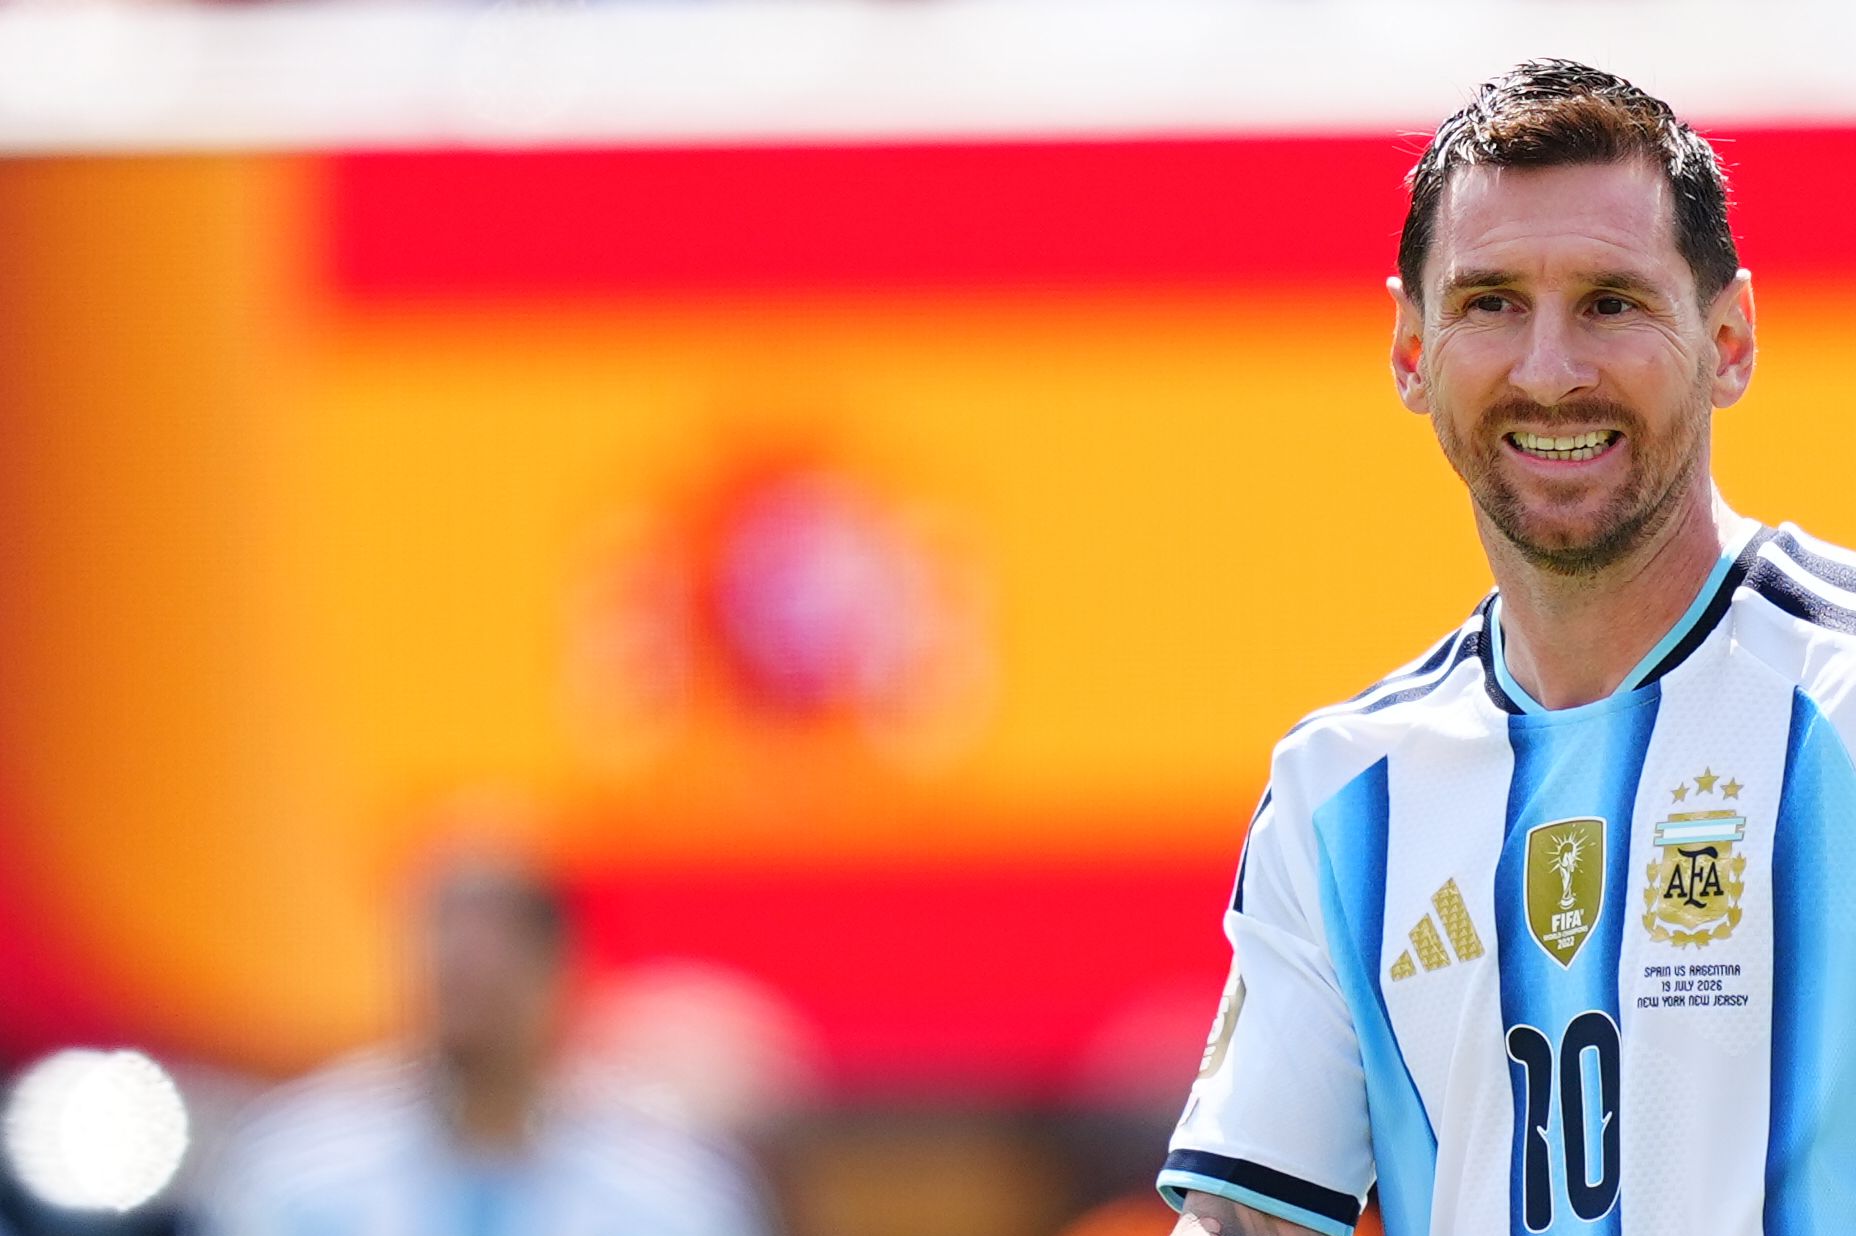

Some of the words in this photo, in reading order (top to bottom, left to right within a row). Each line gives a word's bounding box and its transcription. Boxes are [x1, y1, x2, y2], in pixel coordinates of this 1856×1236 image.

[1663, 846, 1725, 909] AFA
[1551, 909, 1584, 934] FIFA
[1643, 966, 1671, 978] SPAIN
[1689, 964, 1741, 977] ARGENTINA
[1661, 980, 1671, 993] 19
[1674, 980, 1694, 992] JULY
[1697, 979, 1723, 992] 2026
[1637, 996, 1659, 1009] NEW
[1661, 995, 1686, 1007] YORK
[1688, 994, 1710, 1007] NEW
[1713, 994, 1749, 1007] JERSEY
[1505, 1009, 1622, 1234] 10
